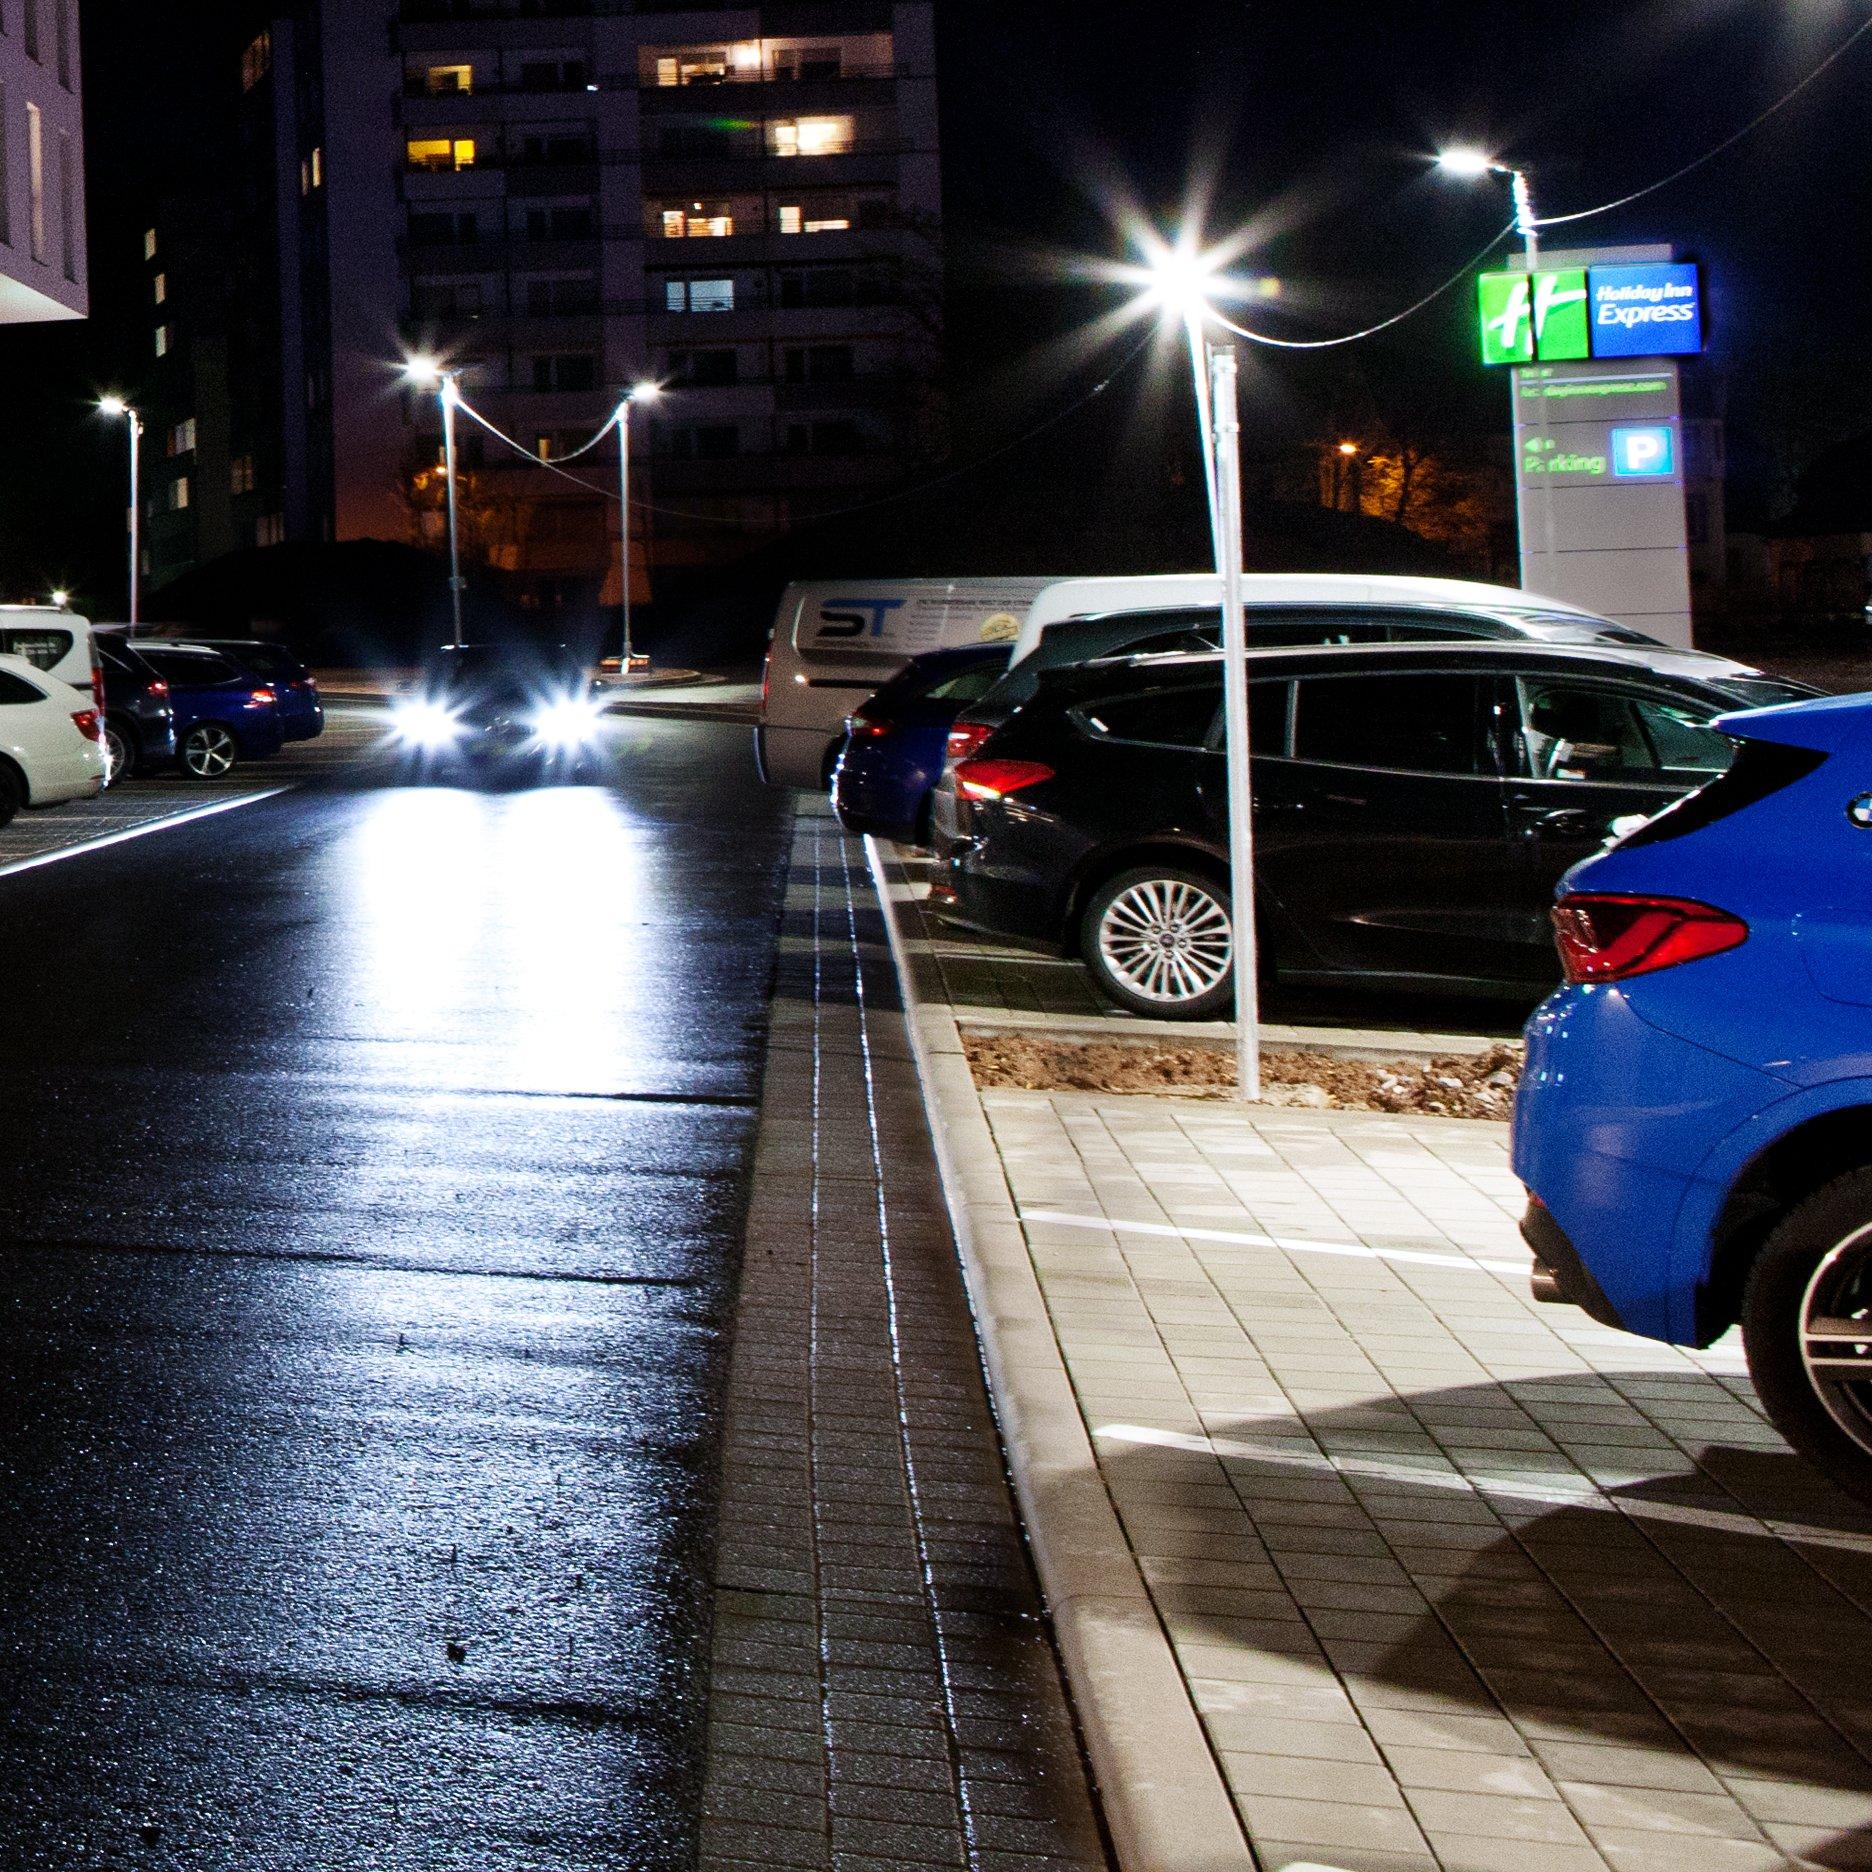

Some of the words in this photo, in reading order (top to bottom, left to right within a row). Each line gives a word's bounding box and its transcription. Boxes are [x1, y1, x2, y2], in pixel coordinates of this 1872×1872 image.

[1597, 284, 1664, 303] Holiday
[1664, 282, 1693, 298] Inn
[1597, 302, 1695, 329] Express
[1626, 435, 1658, 469] P
